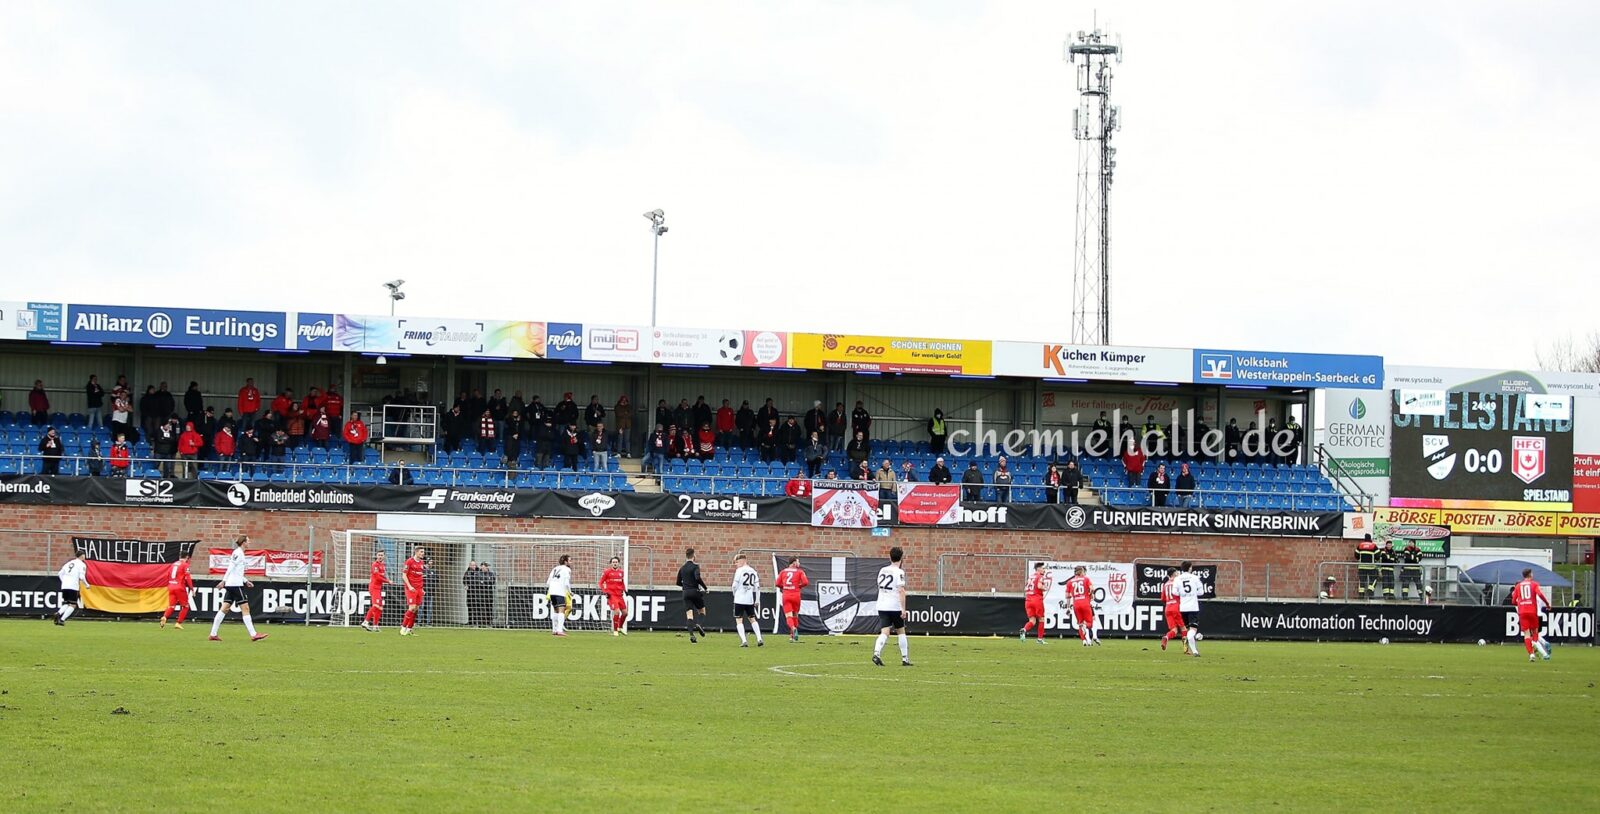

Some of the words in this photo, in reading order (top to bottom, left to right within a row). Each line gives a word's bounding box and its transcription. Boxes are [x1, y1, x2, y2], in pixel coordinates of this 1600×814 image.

[75, 313, 142, 332] Allianz
[186, 315, 278, 342] Eurlings
[298, 324, 333, 337] FRIMO
[404, 331, 431, 341] FRIMO
[547, 335, 582, 347] FRIMO
[594, 335, 634, 344] müller
[846, 346, 885, 355] POCO
[891, 341, 927, 350] SCHÖNES
[928, 343, 962, 352] WOHNEN
[1043, 345, 1096, 375] Küchen
[1100, 352, 1146, 364] Kümper
[1237, 357, 1288, 368] Volksbank
[1237, 369, 1360, 384] Westerkappeln-Saerbeck
[1362, 373, 1376, 383] eG
[1394, 376, 1442, 386] www.syscon.biz
[1547, 382, 1594, 393] www.syscon.biz
[1072, 400, 1088, 409] Hier
[1092, 400, 1117, 409] fallen
[1119, 401, 1133, 410] die
[1394, 389, 1573, 432] SELSTA
[1472, 401, 1496, 411] 24:49
[1329, 423, 1385, 435] GERMAN
[1329, 436, 1384, 448] OEKOTEC
[1425, 438, 1444, 446] SCV
[1517, 441, 1541, 450] HFC
[1340, 460, 1374, 468] Ökologische
[1465, 449, 1502, 473] 0:0
[1574, 457, 1592, 465] Profi
[1330, 468, 1385, 477] Reigungsprodukte
[1574, 468, 1584, 476] ist
[254, 488, 306, 503] Embedded
[308, 490, 354, 504] Solutions
[450, 491, 515, 503] Frankenfeld
[584, 496, 611, 507] Gutfried
[1523, 489, 1569, 502] SPIELSTAND
[464, 502, 512, 511] LOGISTIKGRUPPE
[705, 511, 742, 520] Verpackungen
[1094, 510, 1210, 528] FURNIERWERK
[1214, 513, 1320, 530] SINNERBRINK
[1386, 511, 1436, 526] BÖRSE
[1443, 513, 1495, 528] POSTEN
[1504, 512, 1552, 527] BÖRSE
[75, 539, 166, 563] HALLESCHER
[742, 572, 756, 587] 20
[786, 572, 793, 585] 2
[1143, 567, 1210, 581] Supers
[879, 573, 894, 591] 22
[1072, 580, 1085, 594] 26
[1182, 580, 1192, 594] 5
[820, 586, 843, 595] SCV
[1520, 585, 1532, 600] 10
[263, 588, 386, 615] BECKHOF
[533, 593, 666, 622] BCKOFF
[1044, 604, 1164, 630] BEHOFF
[1241, 613, 1273, 629] New
[1276, 614, 1355, 630] Automation
[1358, 615, 1433, 635] Technology
[1505, 612, 1595, 637] BCKHO
